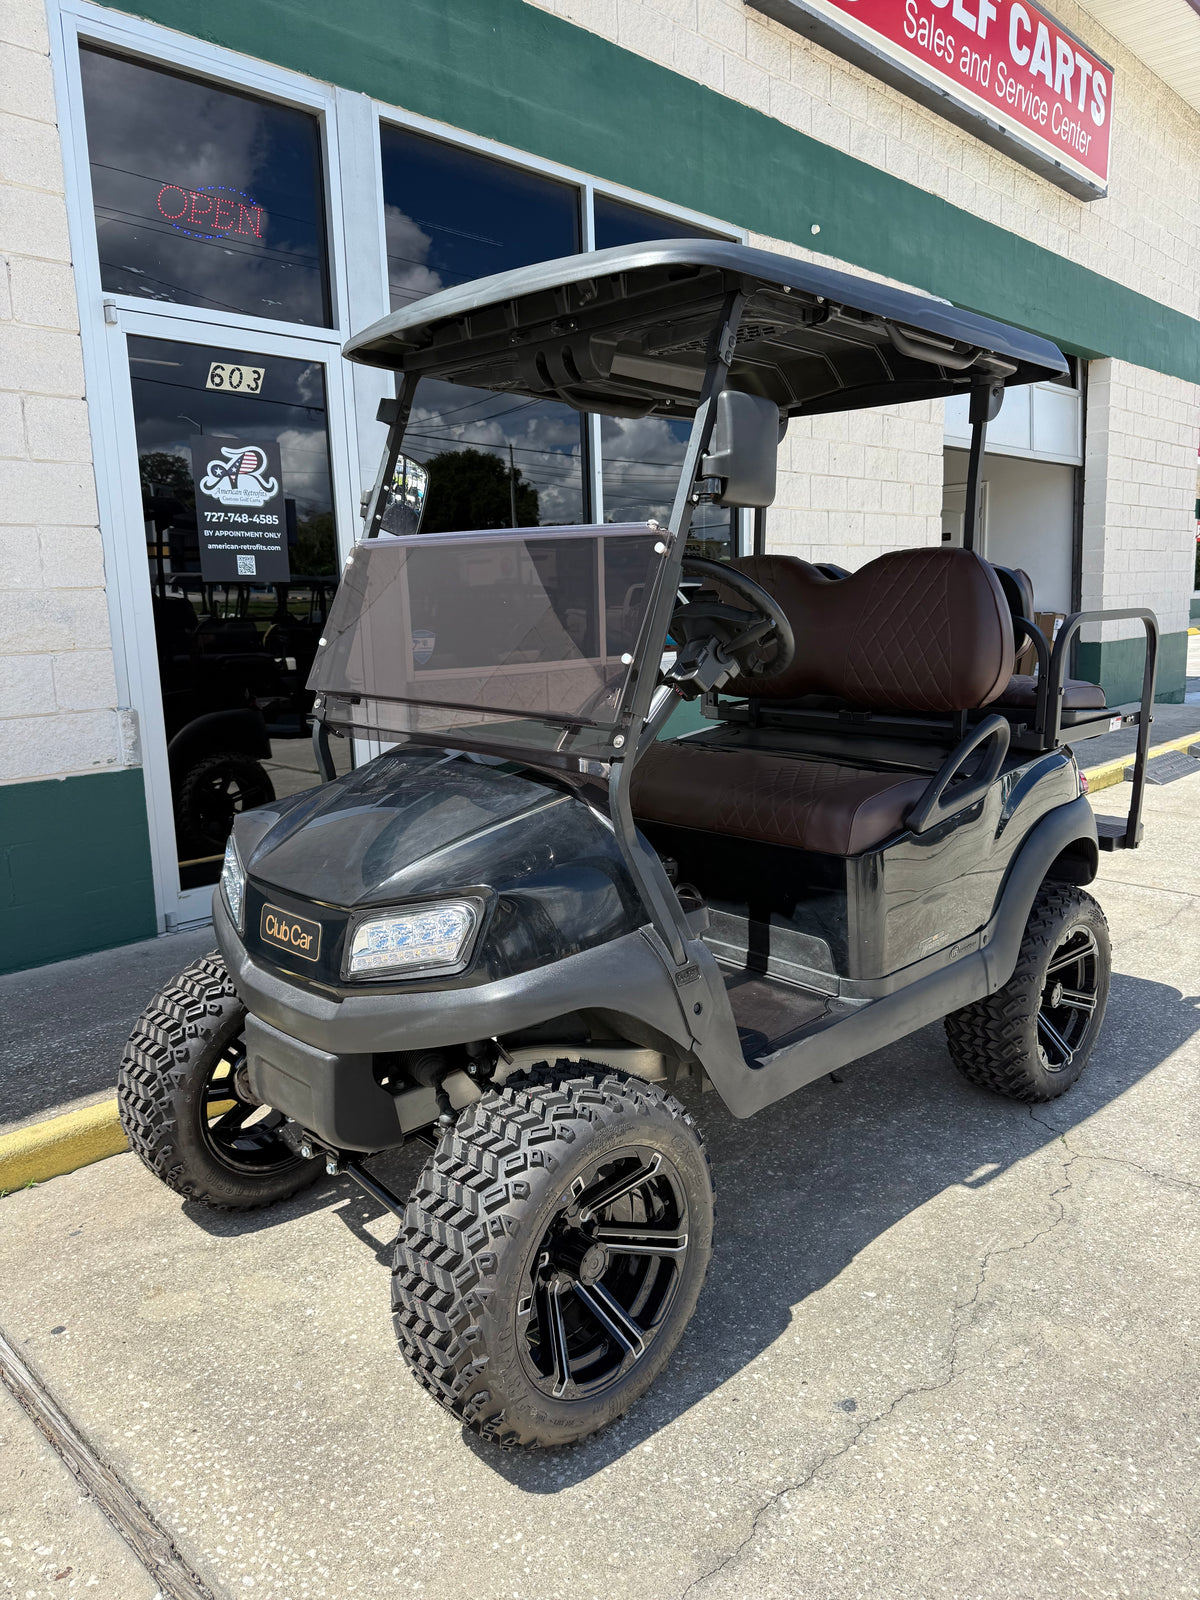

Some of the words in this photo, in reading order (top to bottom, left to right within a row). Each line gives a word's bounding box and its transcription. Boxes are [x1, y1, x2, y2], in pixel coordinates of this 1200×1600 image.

[903, 0, 956, 64] Sales
[960, 46, 992, 88] and
[995, 61, 1048, 126] Service
[1052, 102, 1092, 156] Center
[1009, 3, 1107, 127] CARTS
[157, 185, 263, 238] OPEN
[210, 364, 262, 392] 603
[215, 487, 242, 496] American
[243, 489, 268, 499] Retrofits
[204, 511, 279, 525] 727-748-4585
[204, 529, 214, 537] BY
[214, 530, 264, 538] APPOINTMENT
[207, 542, 282, 551] american-retrofits.com
[265, 914, 290, 942] Club
[290, 924, 313, 951] Car
